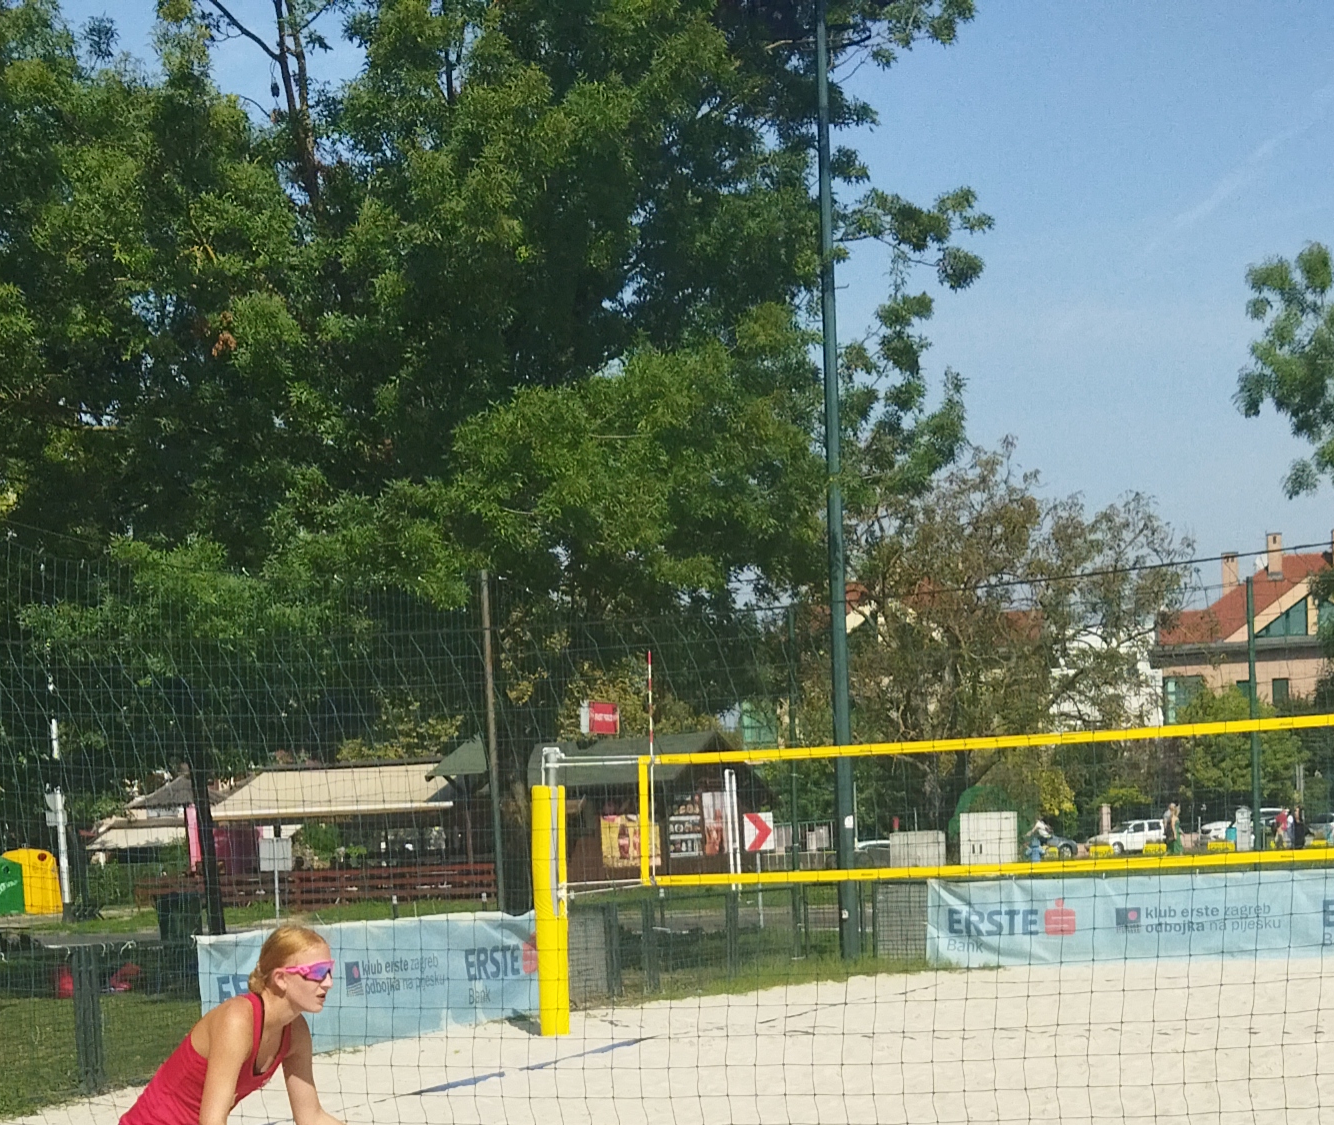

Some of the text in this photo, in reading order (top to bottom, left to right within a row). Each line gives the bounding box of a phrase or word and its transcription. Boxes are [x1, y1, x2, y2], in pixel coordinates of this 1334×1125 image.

[1145, 902, 1271, 920] klub erste zagreb
[948, 907, 1039, 937] ERSTE
[1145, 916, 1281, 935] odbojka na pijesku
[947, 938, 984, 954] Bank
[361, 959, 383, 976] klub
[385, 957, 409, 974] erste
[465, 944, 521, 981] ERSTE
[364, 976, 401, 996] odbojka
[403, 979, 414, 991] na
[469, 985, 491, 1005] Bank
